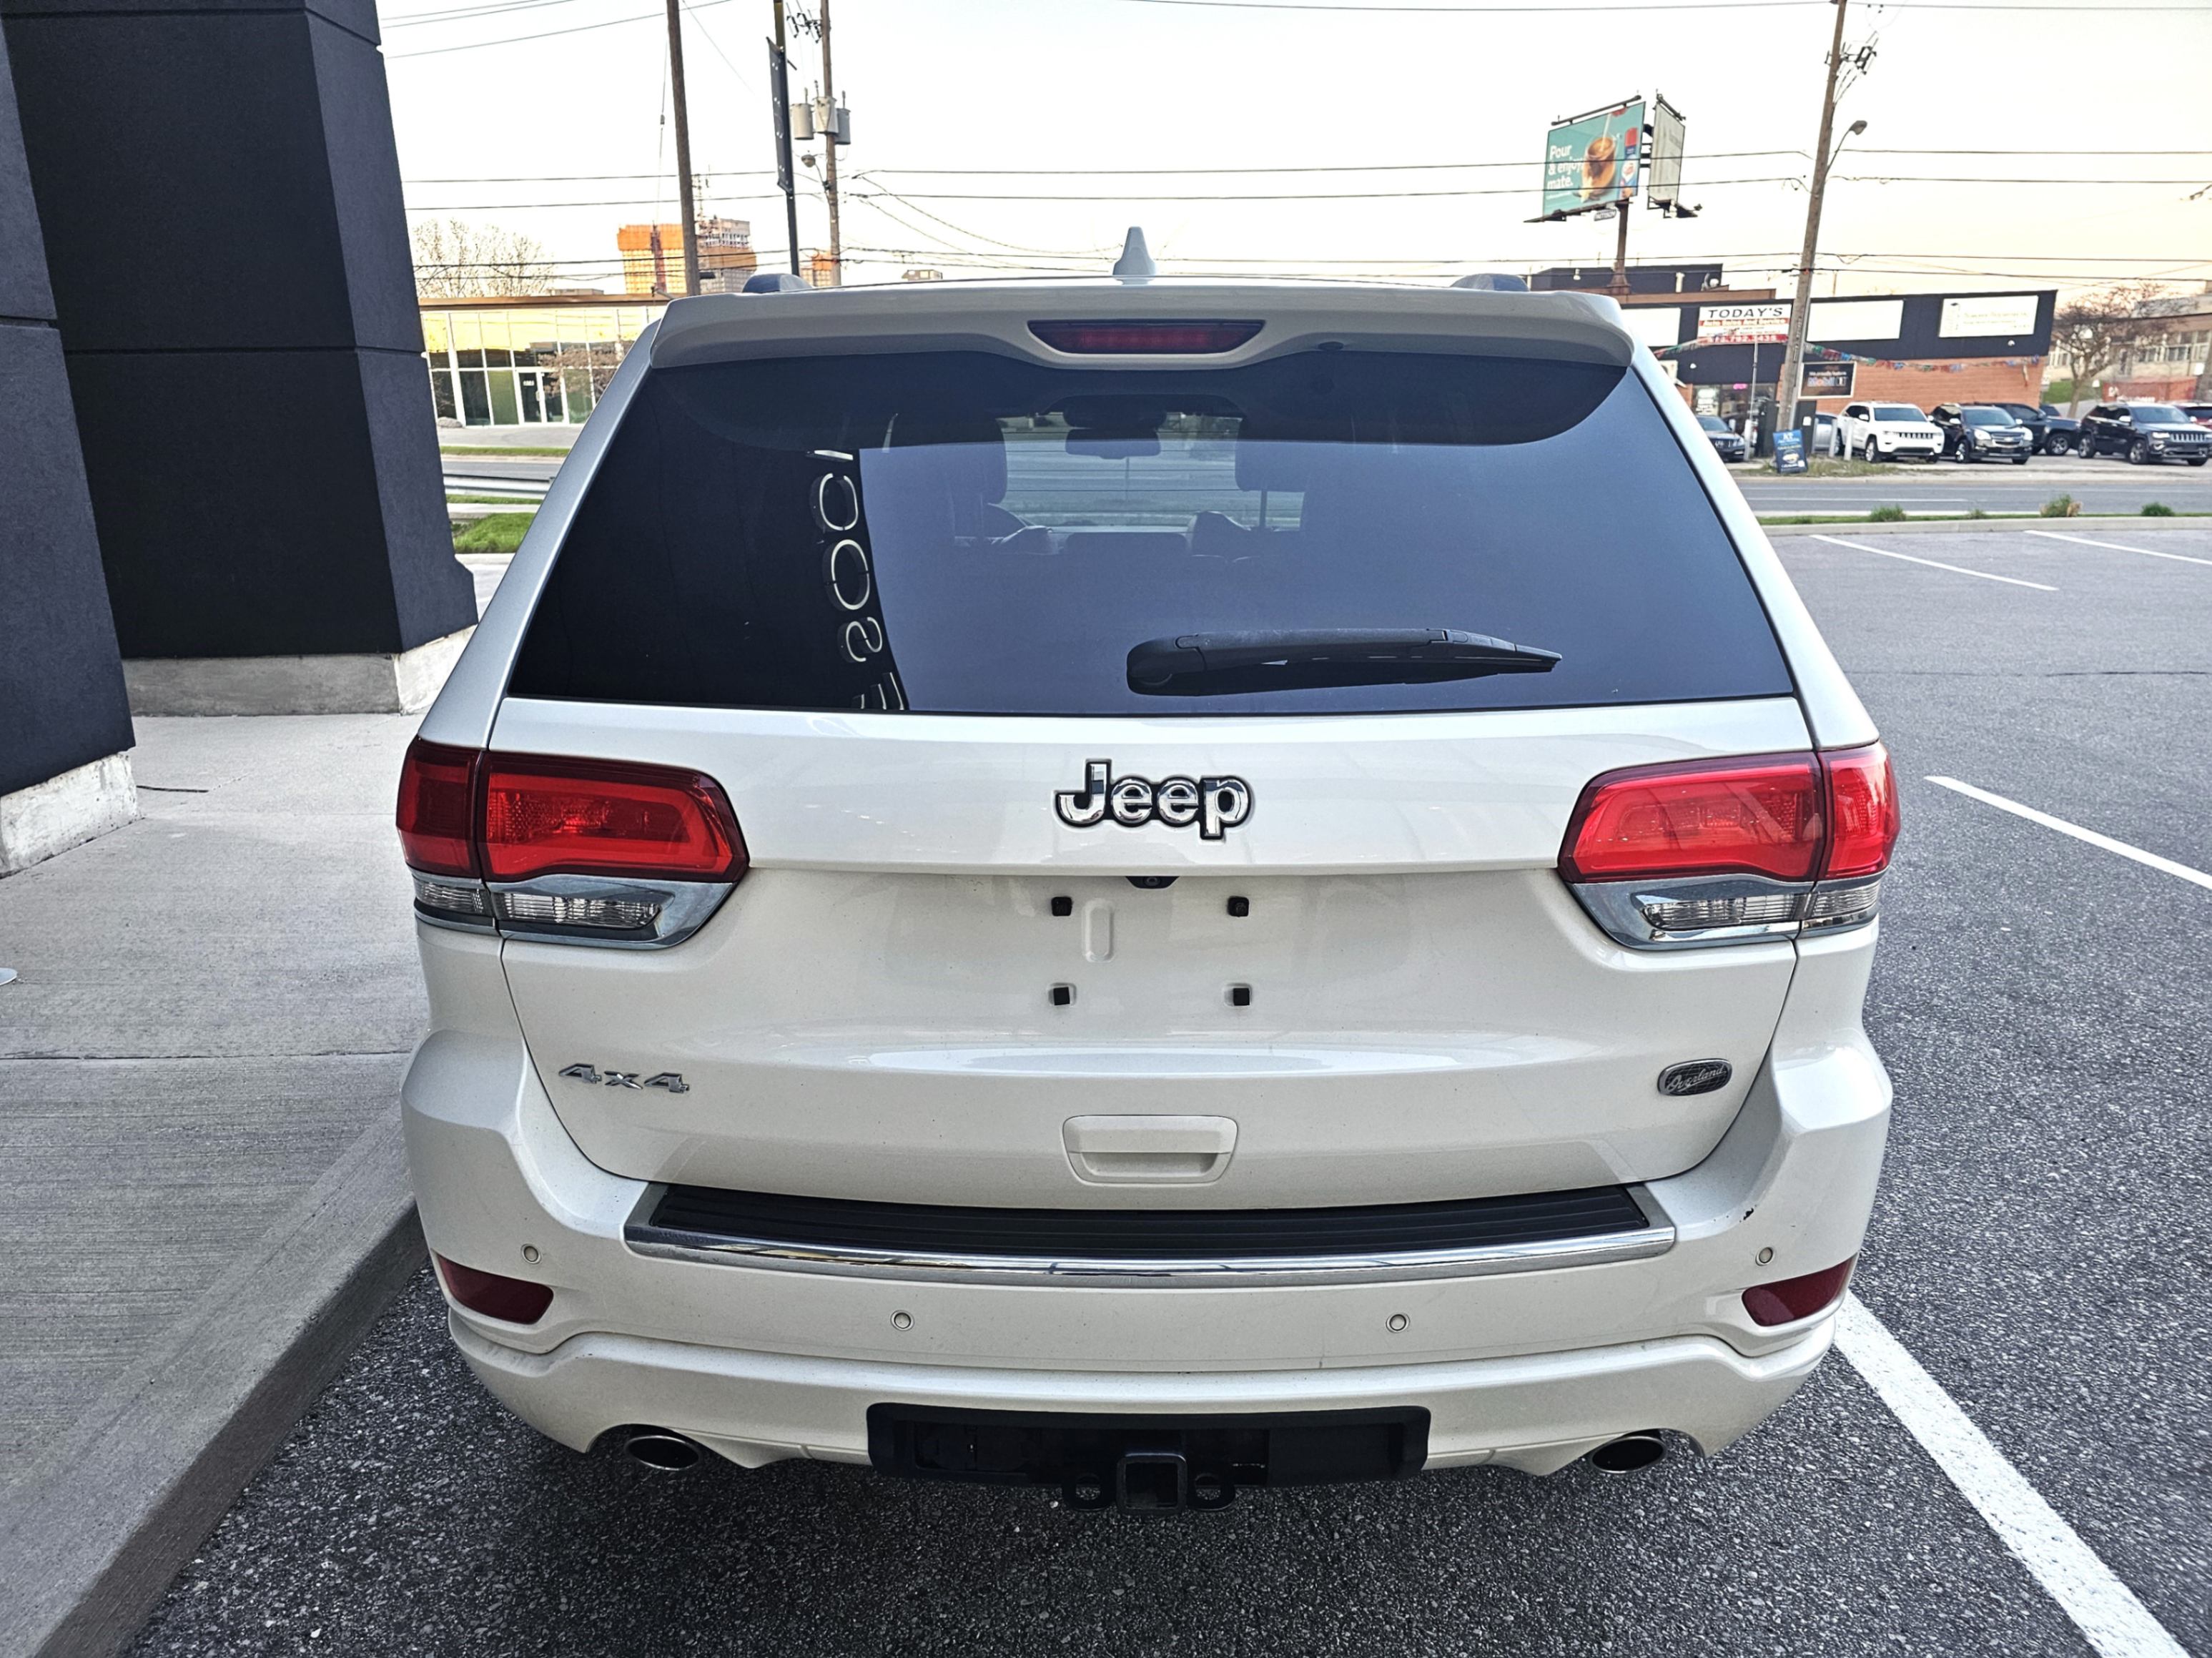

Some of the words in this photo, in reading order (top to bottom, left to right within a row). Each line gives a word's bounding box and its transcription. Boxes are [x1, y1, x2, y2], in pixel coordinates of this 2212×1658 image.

[1549, 145, 1572, 160] Pour
[1708, 307, 1783, 319] TODAY'S
[1054, 759, 1253, 840] Jeep
